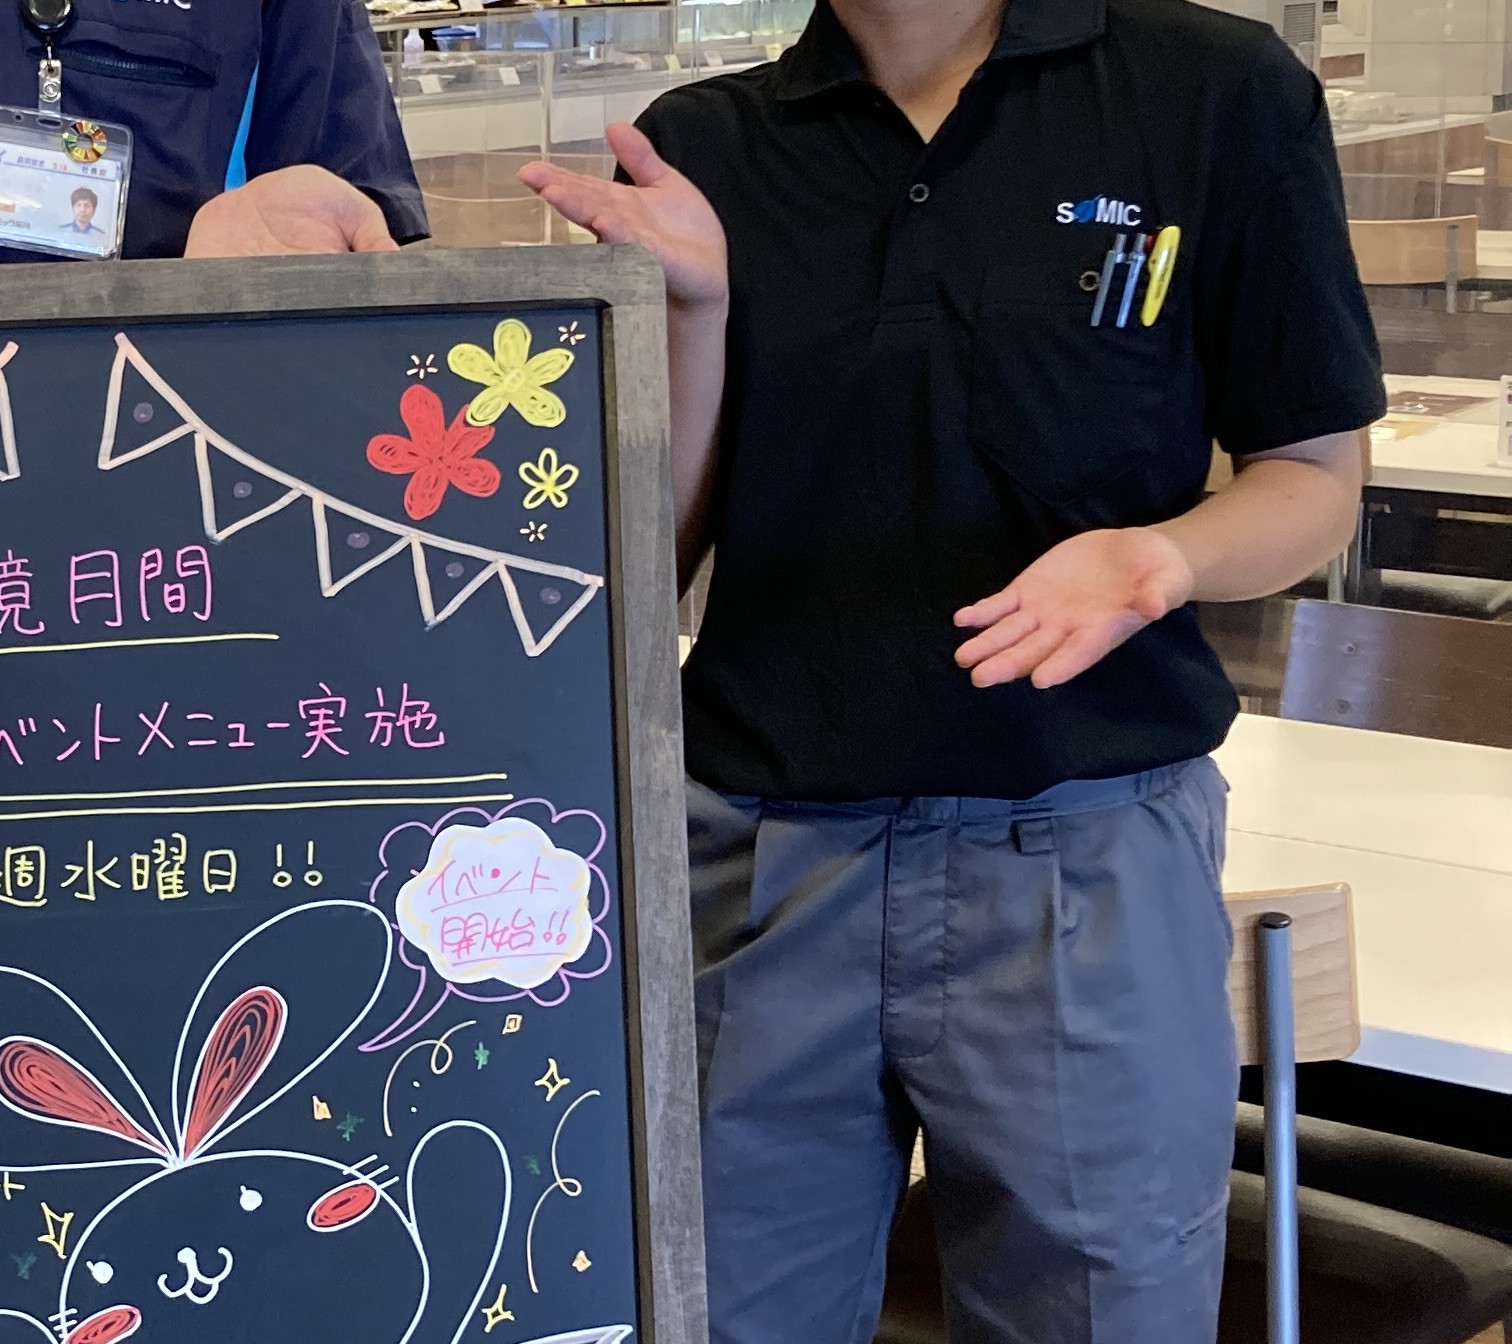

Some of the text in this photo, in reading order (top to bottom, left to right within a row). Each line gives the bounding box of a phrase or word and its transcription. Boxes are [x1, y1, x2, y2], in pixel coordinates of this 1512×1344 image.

[1055, 194, 1142, 227] SOMIC
[427, 855, 550, 904] イベント
